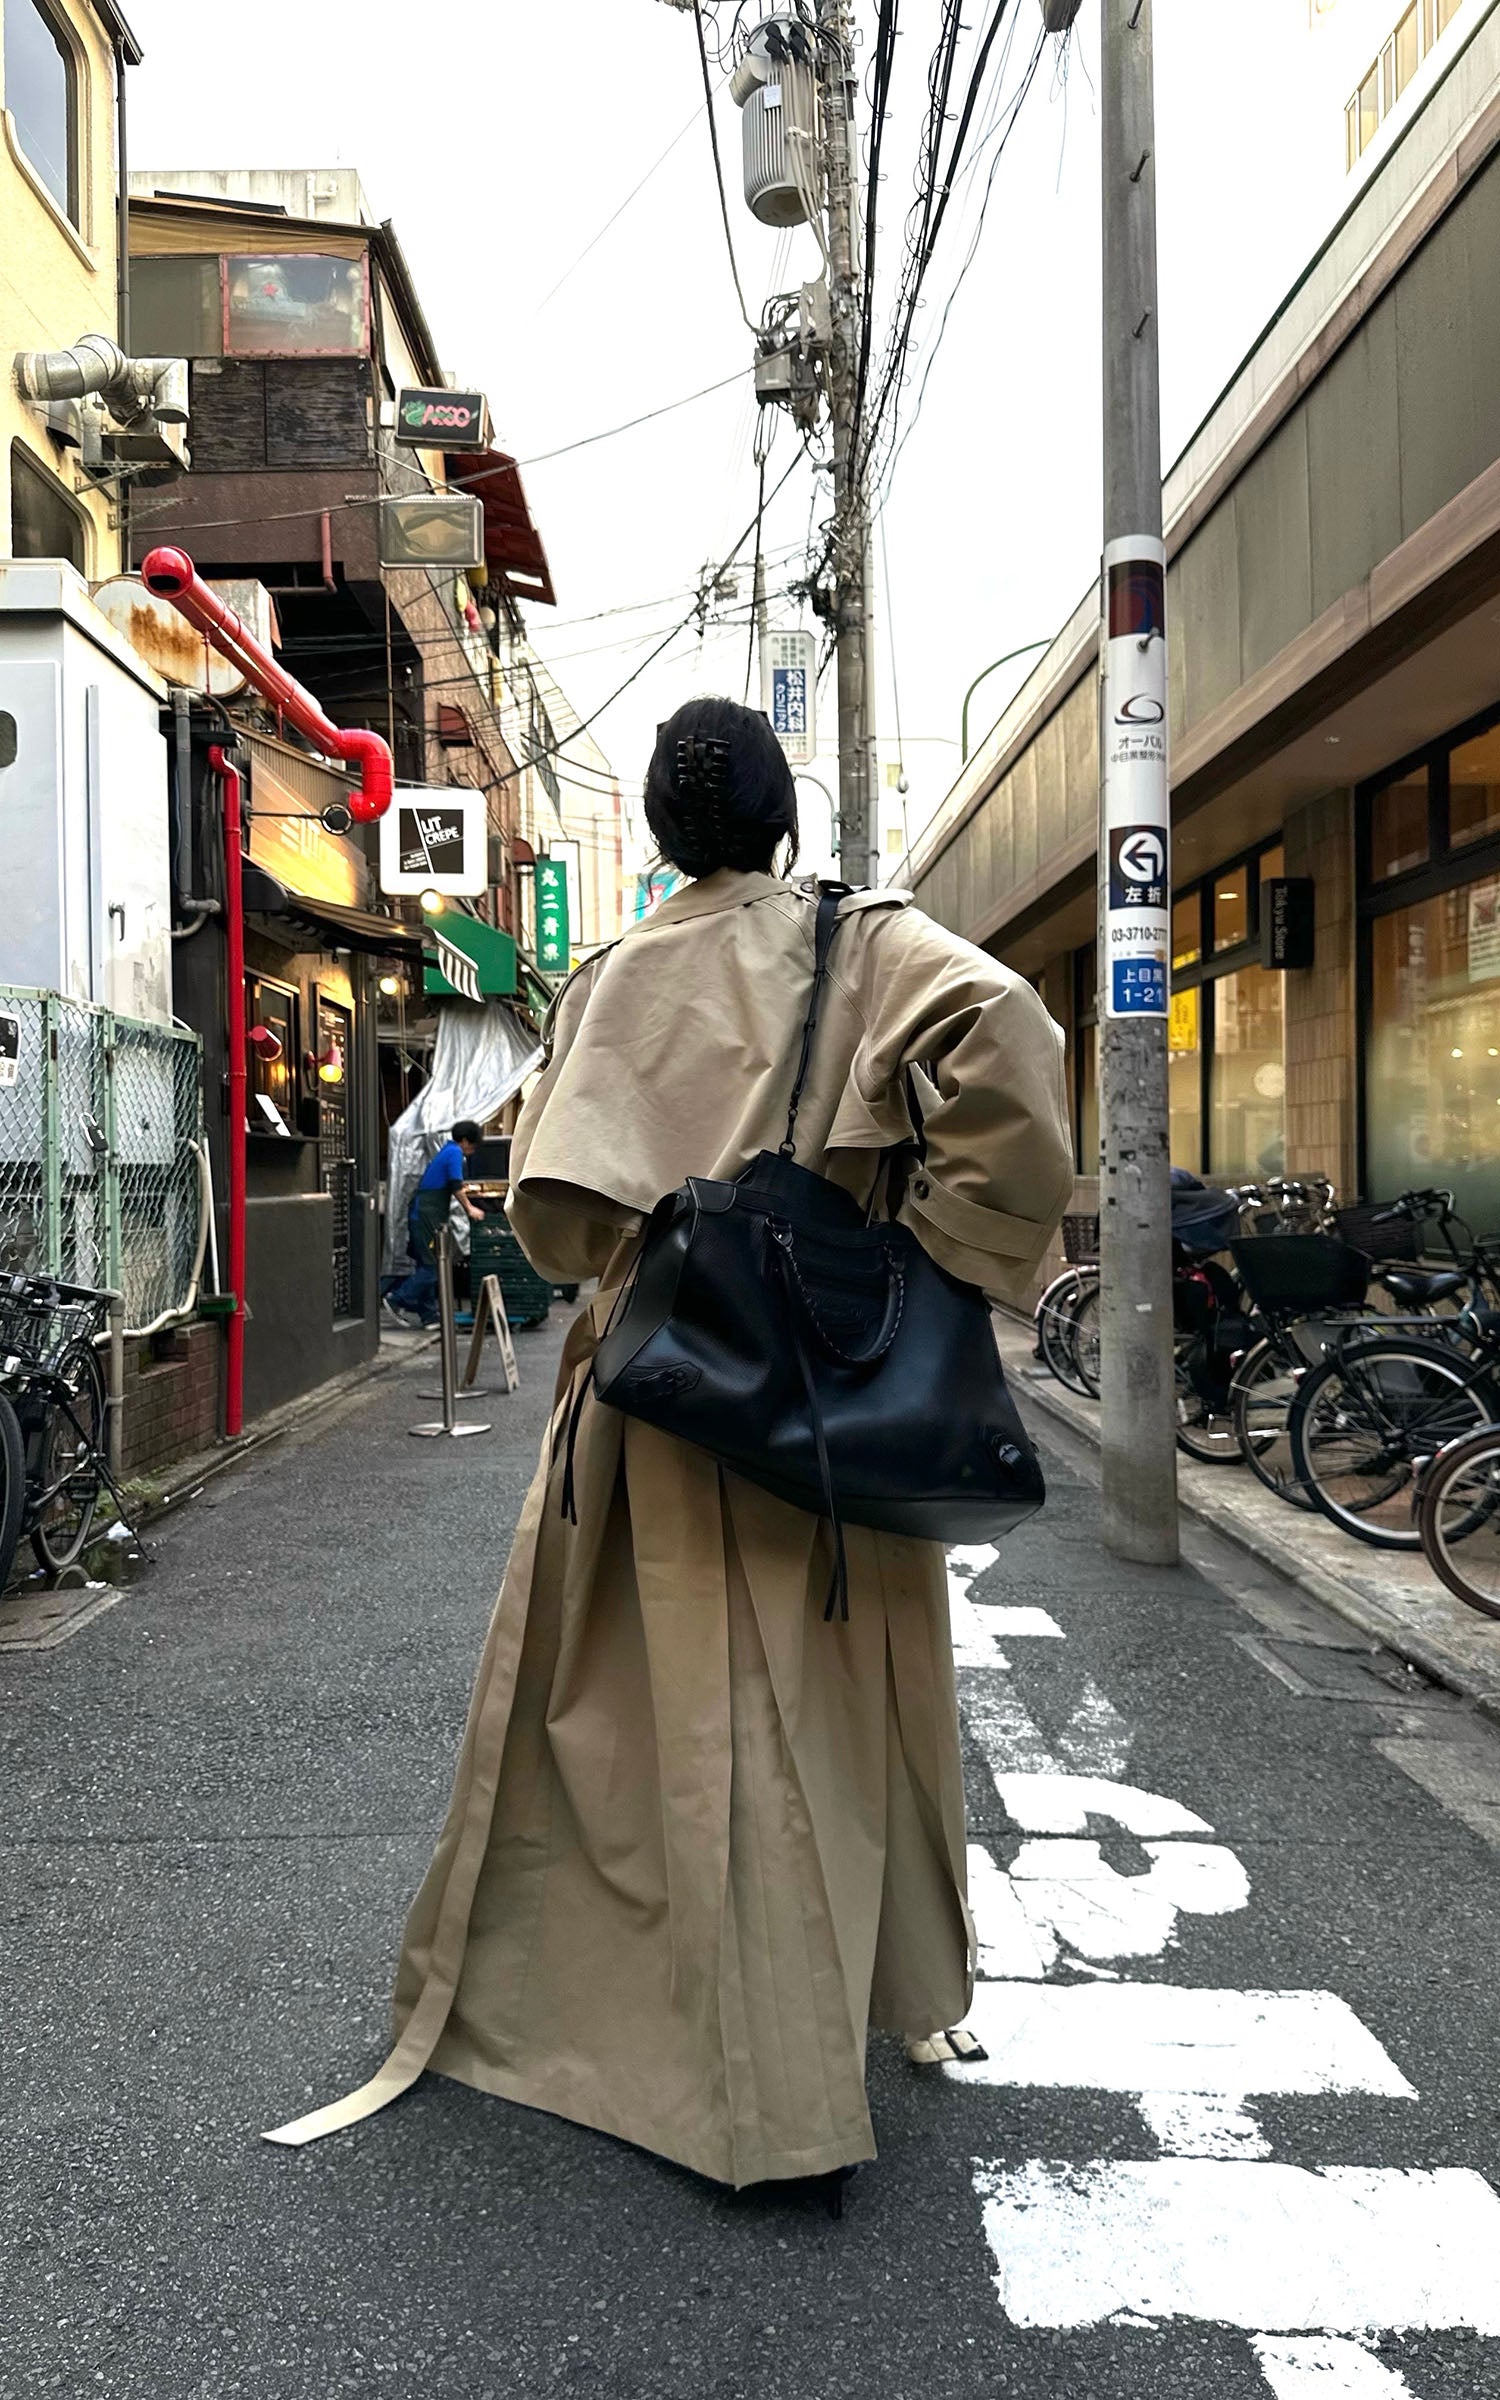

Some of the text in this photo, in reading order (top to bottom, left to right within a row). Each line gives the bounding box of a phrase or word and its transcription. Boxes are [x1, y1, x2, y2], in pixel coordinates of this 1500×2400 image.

[775, 682, 786, 732] クリニック
[786, 670, 805, 732] 松井内科
[1111, 749, 1167, 763] 中目黒整形外
[421, 815, 442, 835] LIT
[425, 826, 460, 846] CREPE
[541, 867, 560, 962] 丸二青果
